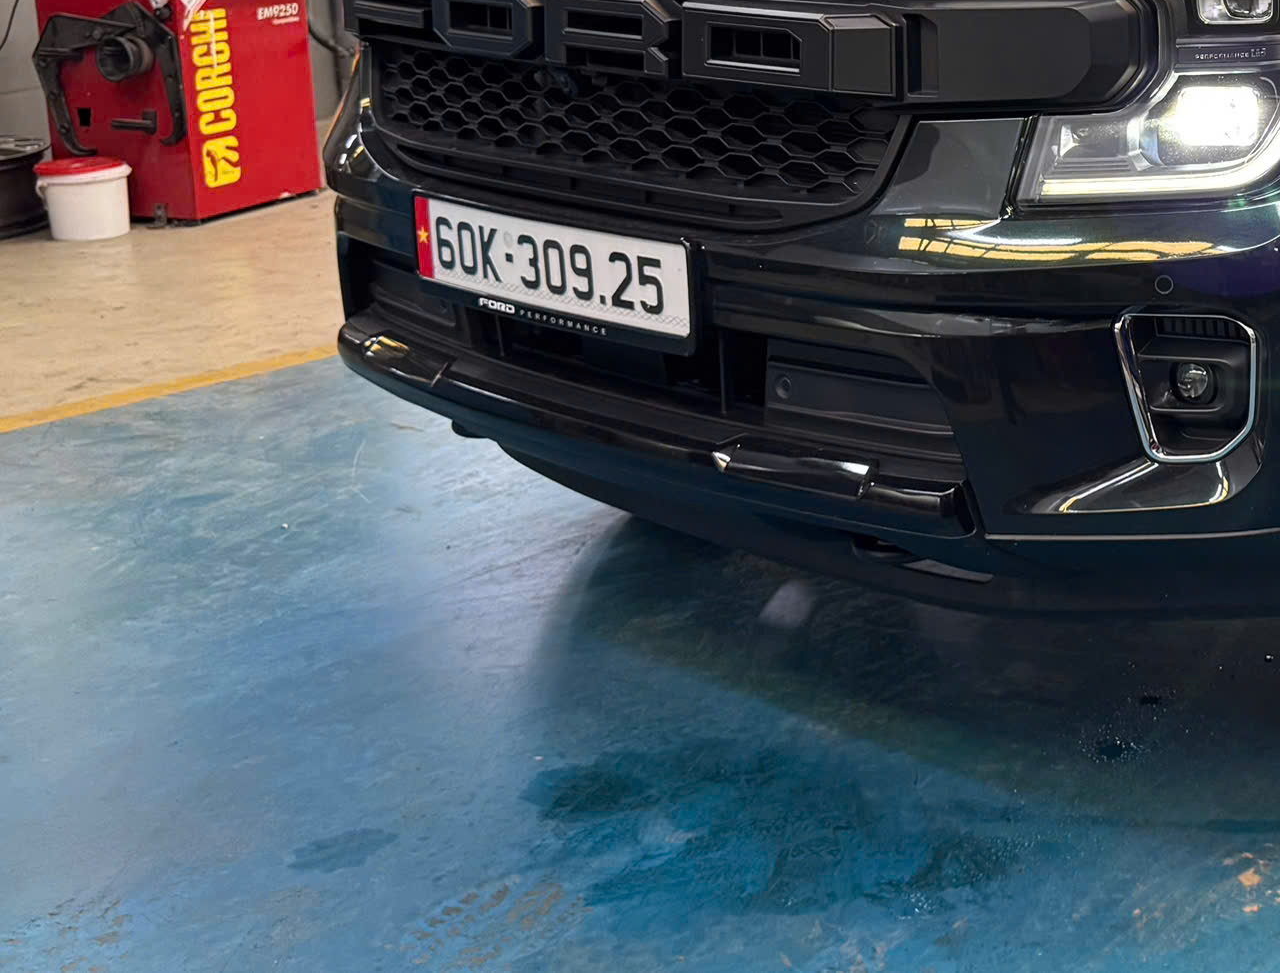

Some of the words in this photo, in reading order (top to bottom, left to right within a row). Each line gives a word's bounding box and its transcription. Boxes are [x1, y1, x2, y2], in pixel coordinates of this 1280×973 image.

[257, 2, 299, 21] EM9250
[190, 7, 238, 136] CORGHI
[478, 296, 516, 315] FORD
[519, 308, 608, 337] PERFORMANCE
